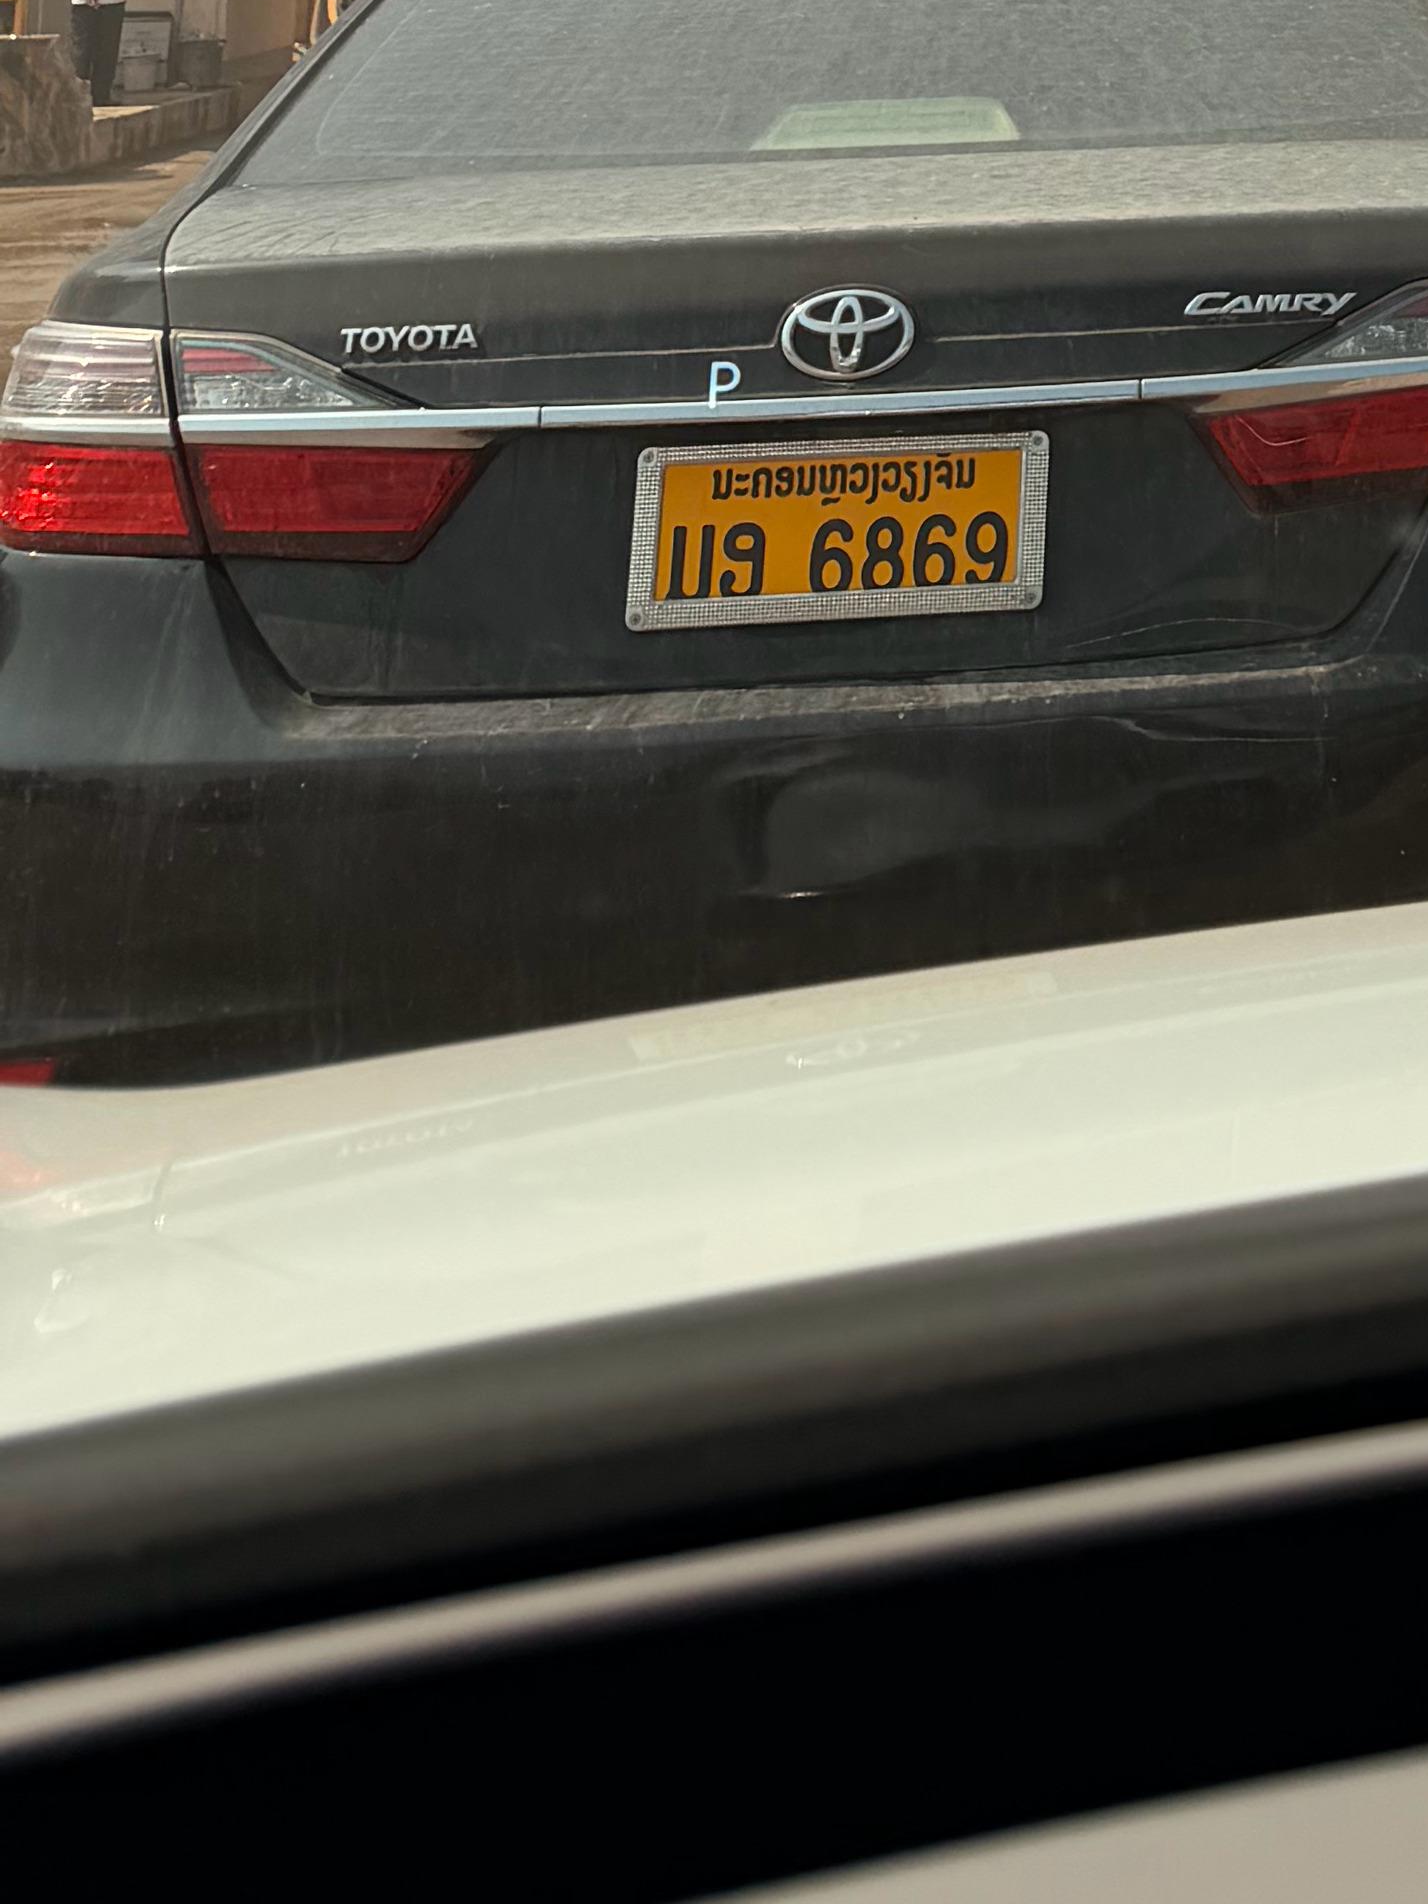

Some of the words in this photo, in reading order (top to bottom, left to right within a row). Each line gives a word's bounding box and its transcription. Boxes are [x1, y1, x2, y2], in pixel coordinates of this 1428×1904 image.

[1184, 291, 1358, 317] CAMRY
[340, 323, 479, 355] TOYOTA
[707, 360, 741, 410] P
[809, 510, 1009, 594] 6869
